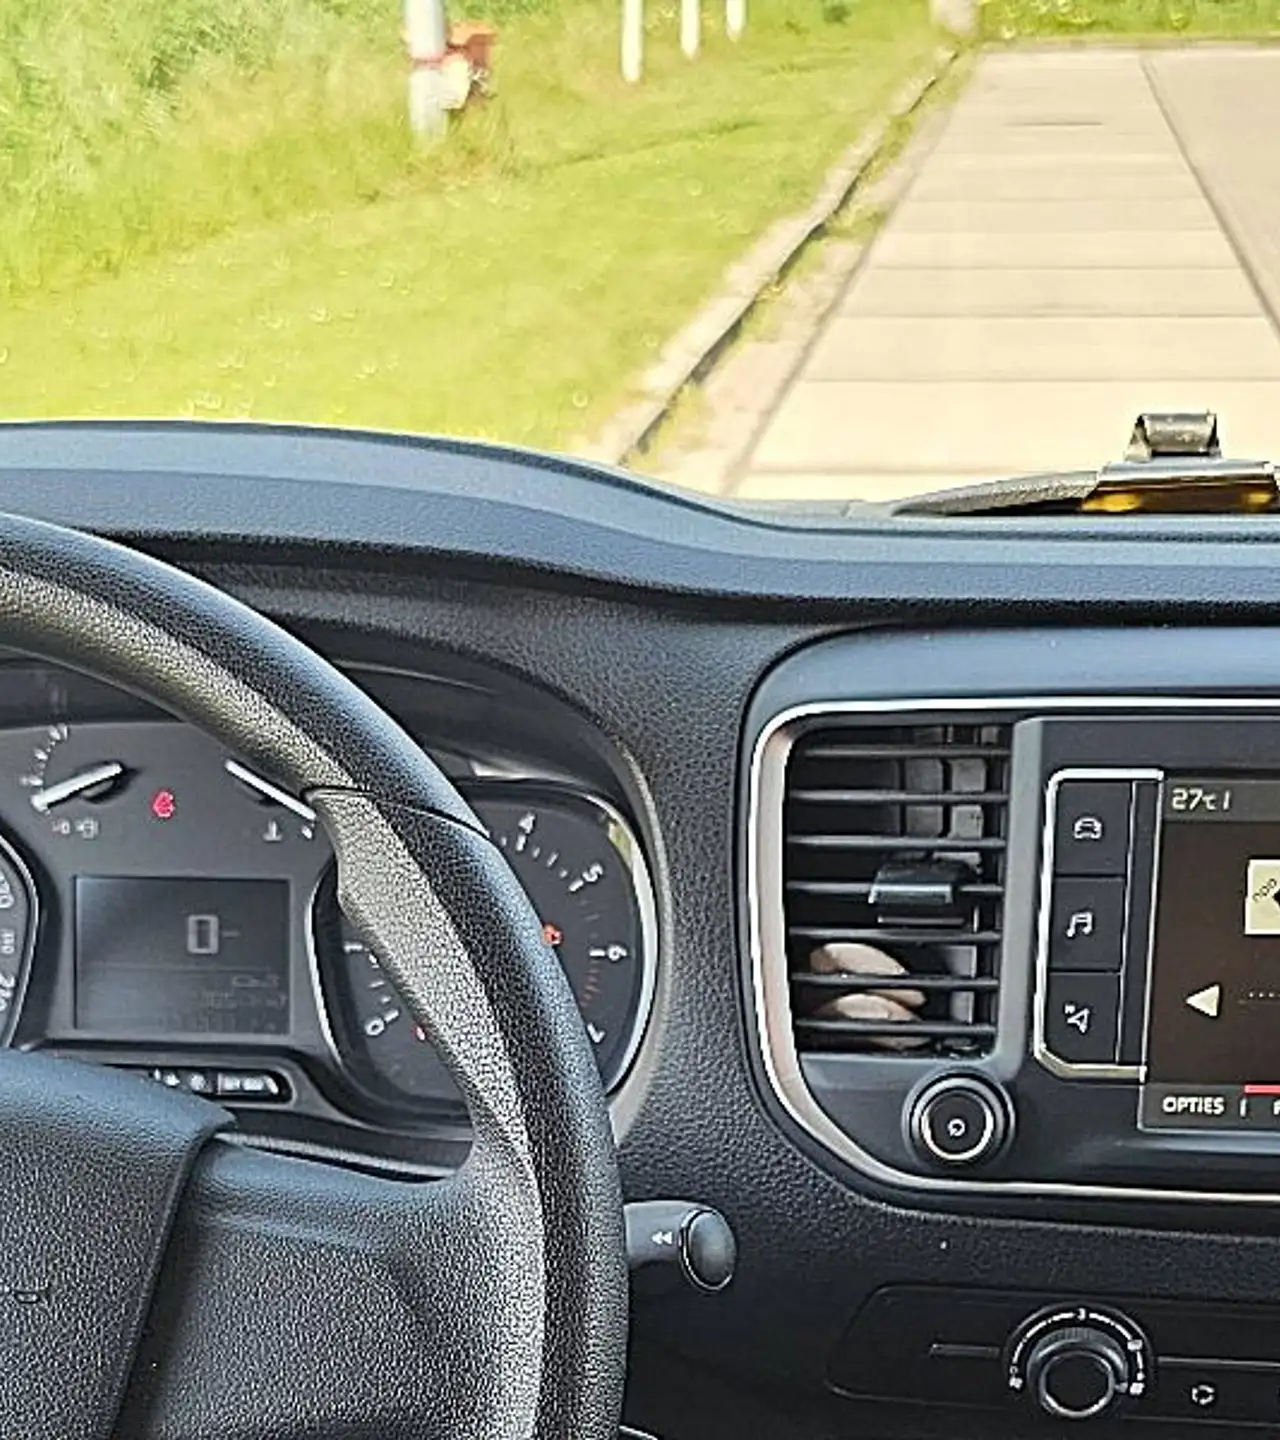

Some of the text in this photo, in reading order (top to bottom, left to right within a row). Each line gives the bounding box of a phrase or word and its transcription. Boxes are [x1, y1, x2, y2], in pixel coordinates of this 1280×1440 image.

[519, 812, 536, 834] 4
[583, 861, 604, 883] 5
[187, 915, 219, 954] 0
[606, 945, 628, 960] 6
[365, 1018, 384, 1036] 0
[1162, 1096, 1224, 1115] OPTIES
